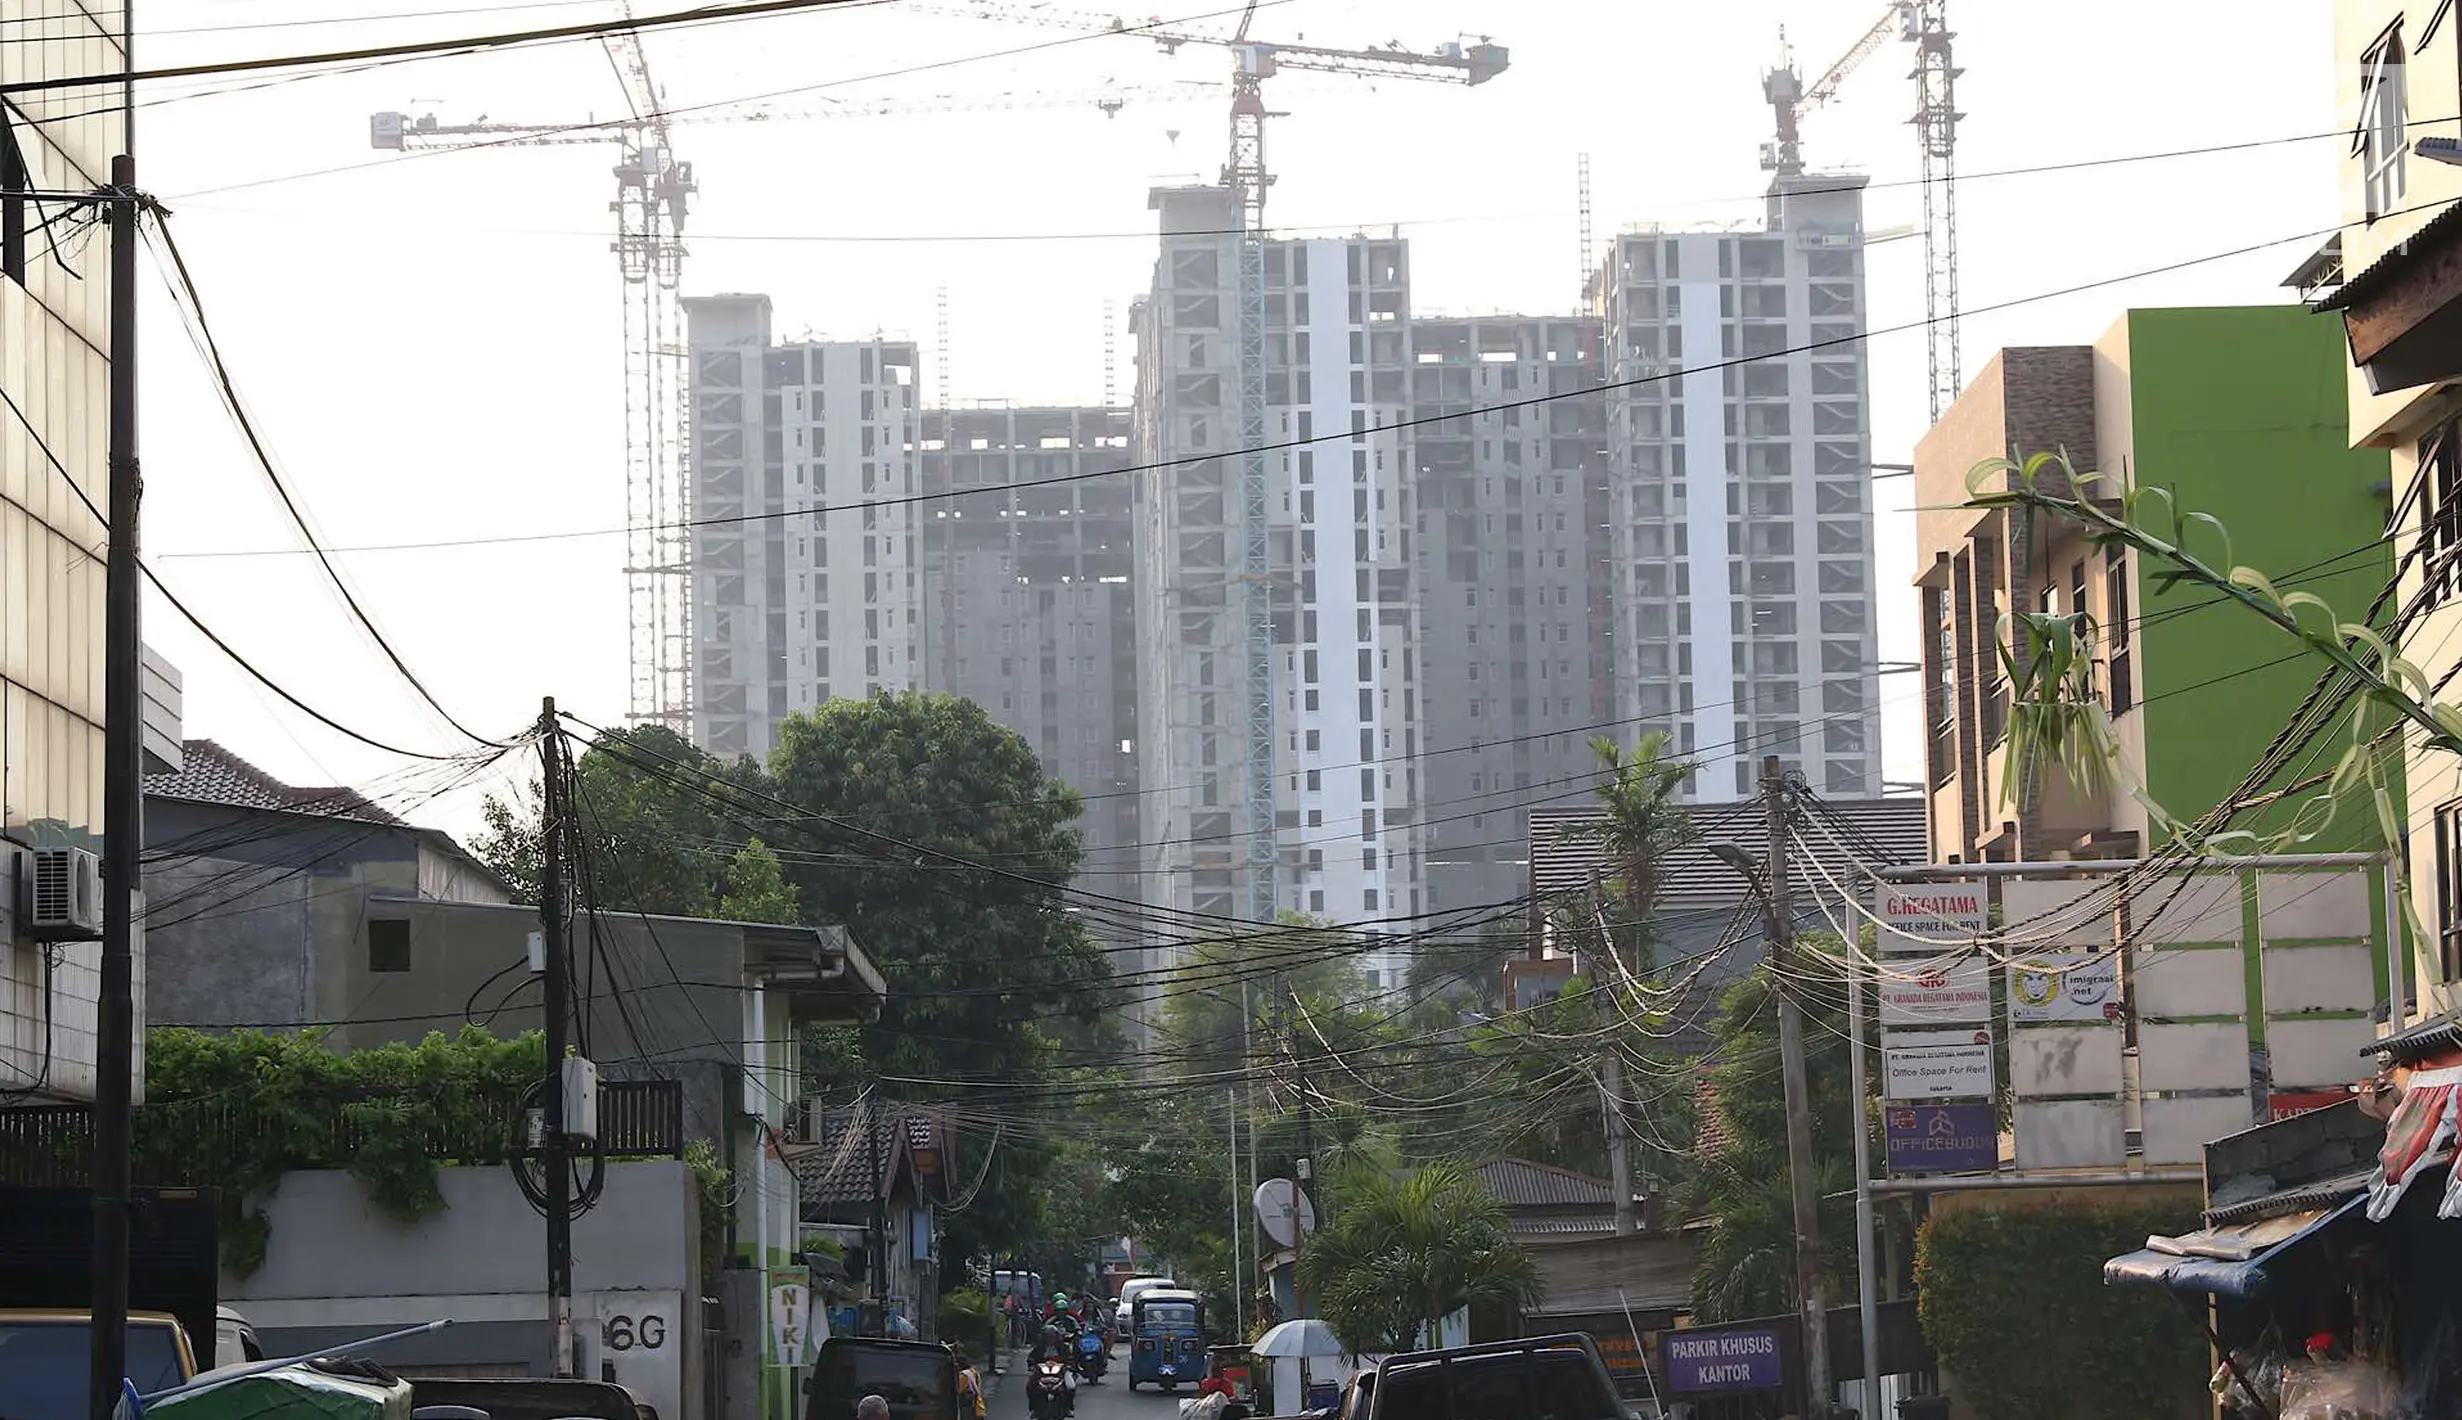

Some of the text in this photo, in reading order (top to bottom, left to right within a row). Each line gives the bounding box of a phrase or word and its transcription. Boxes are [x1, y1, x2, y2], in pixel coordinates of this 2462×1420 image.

[1915, 921, 1939, 932] SPACE
[1892, 1064, 1987, 1078] Office Space For Rent
[782, 1288, 799, 1364] NIKI
[1671, 1335, 1773, 1359] PARKIR KHUSUS
[1699, 1363, 1751, 1384] KANTOR
